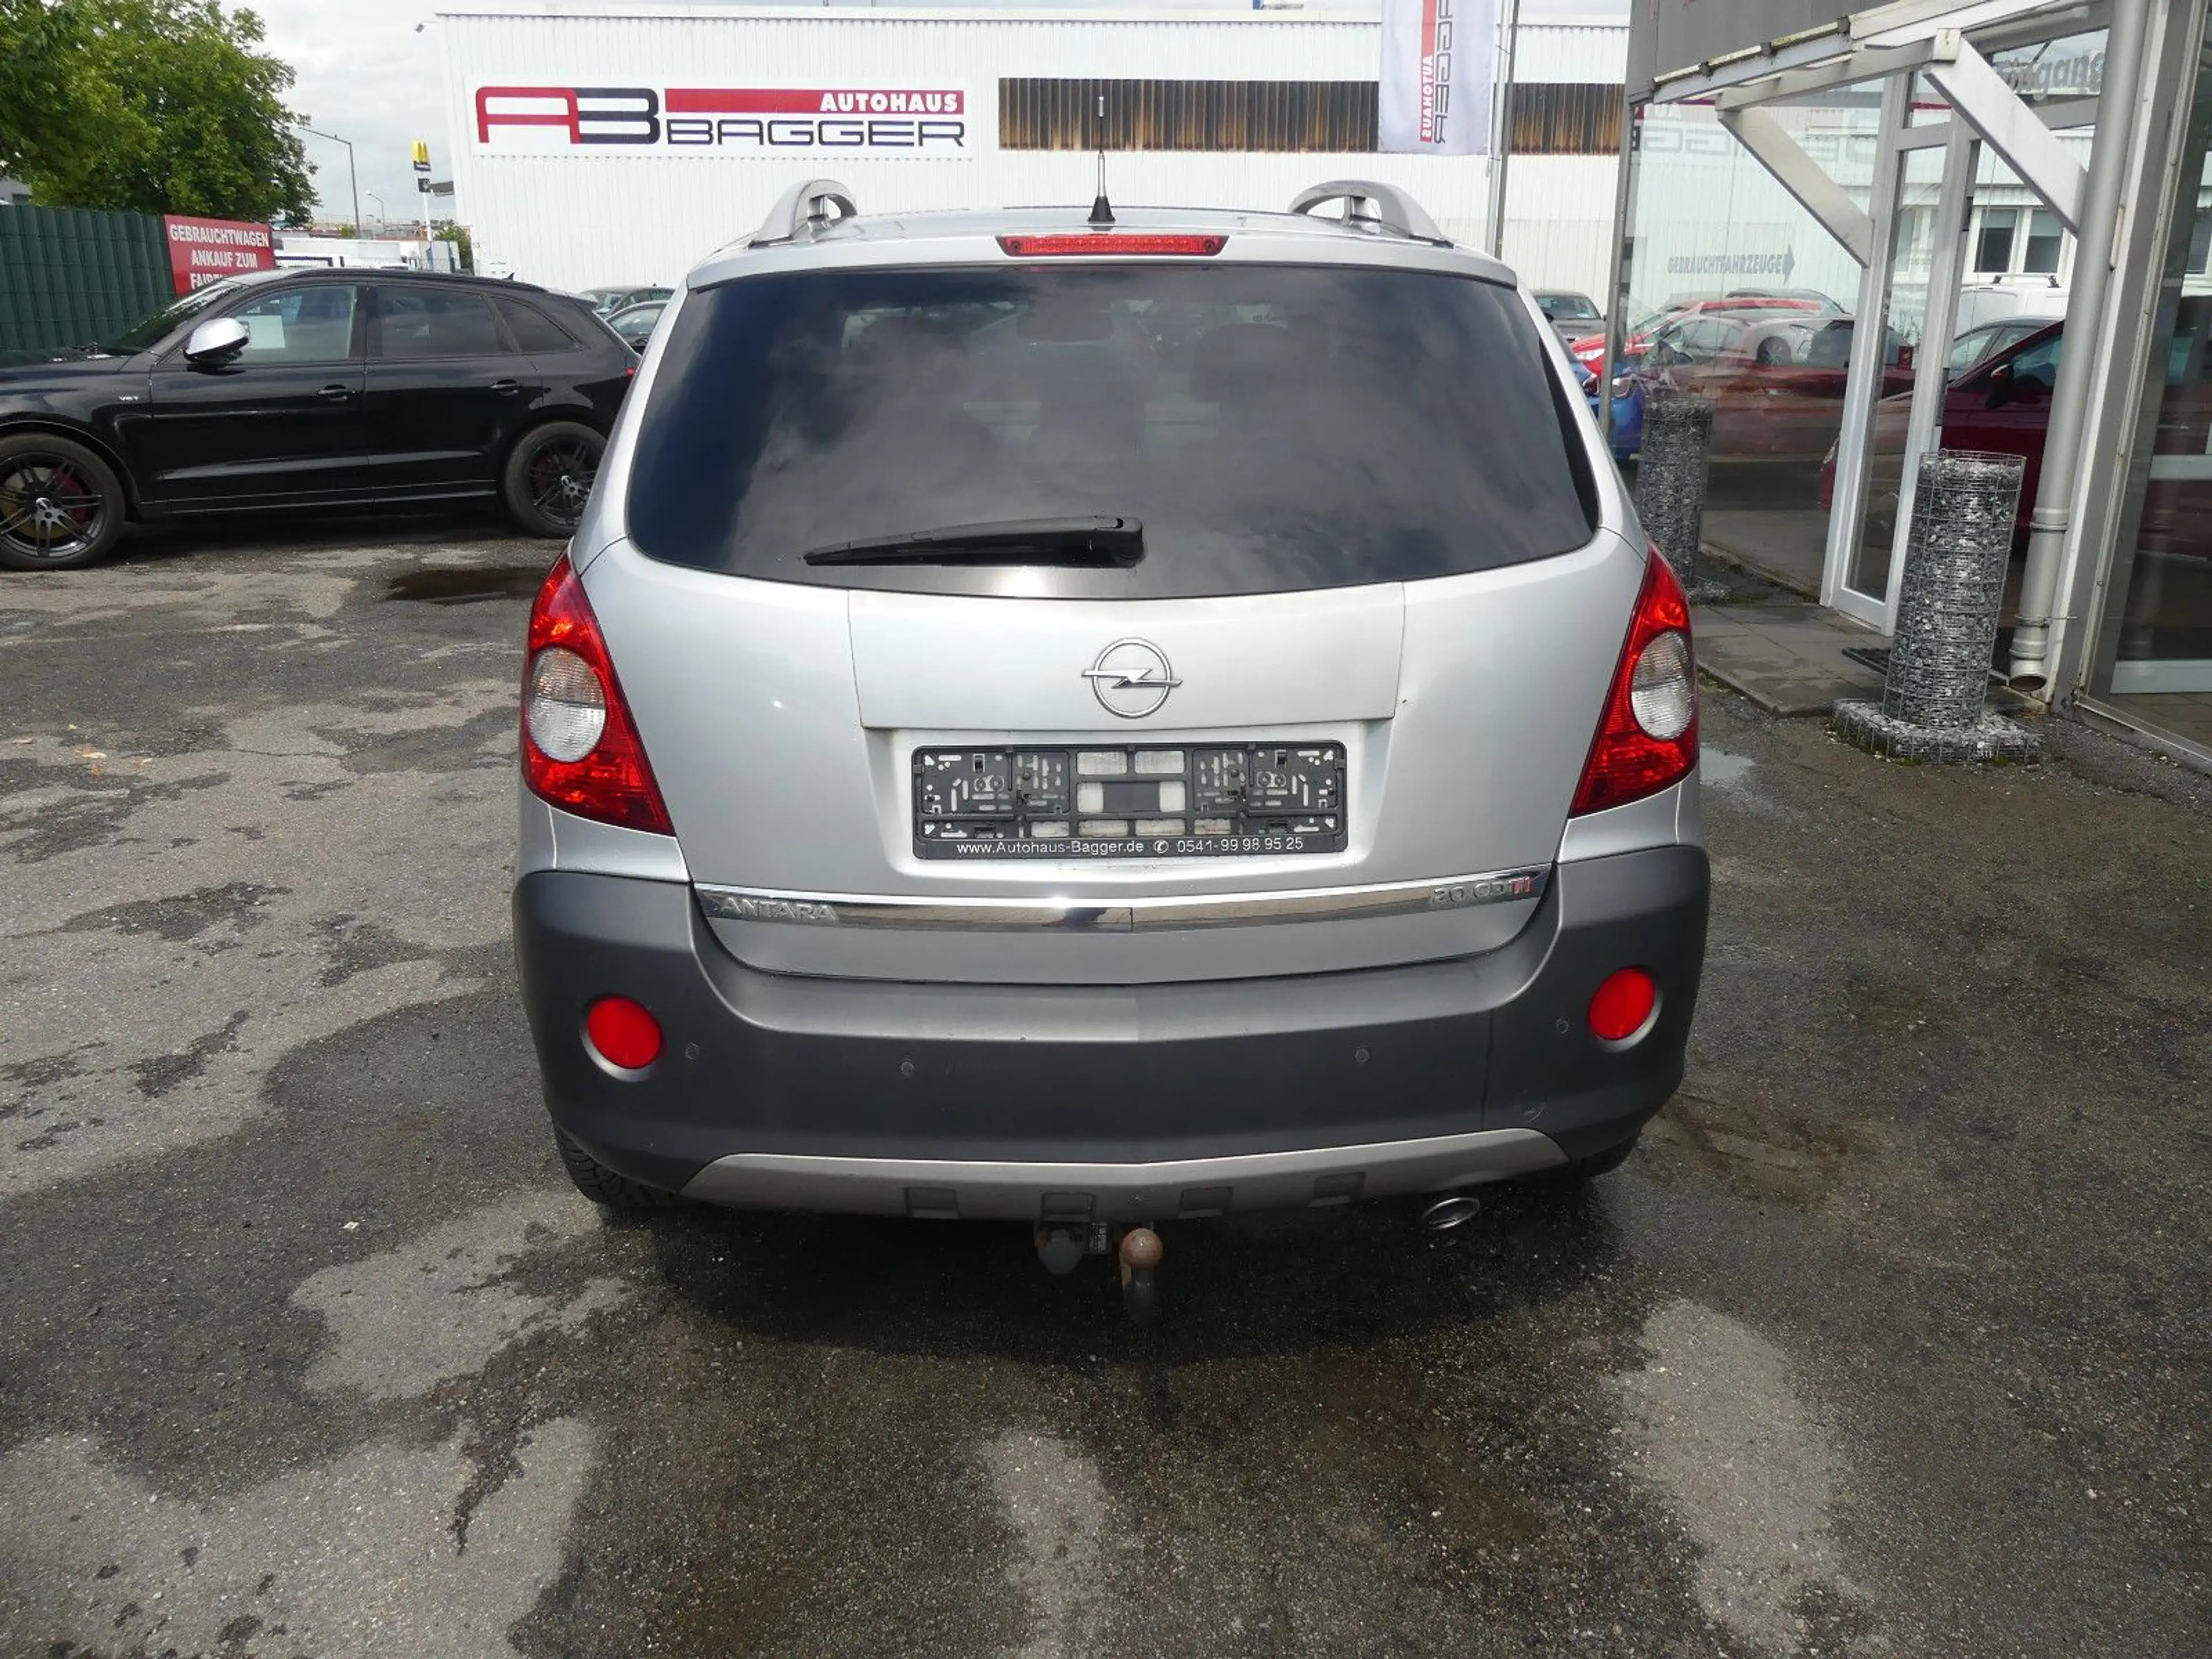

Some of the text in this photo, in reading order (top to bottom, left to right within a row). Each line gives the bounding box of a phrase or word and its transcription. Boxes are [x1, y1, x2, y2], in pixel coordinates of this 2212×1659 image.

[820, 92, 959, 112] AUTOHAUS
[1421, 55, 1434, 138] AUTOHAUS
[667, 118, 965, 148] BAGGER
[170, 224, 270, 247] GEBRAUCHTWAGEN
[191, 249, 258, 268] ANKAUF ZUM
[1666, 253, 1783, 274] GEBRAUCHTFAHRZEUGE
[956, 840, 1144, 855] www.Autohaus-Bagger.de
[1242, 838, 1260, 851] 98
[1264, 837, 1282, 850] 95
[1285, 836, 1304, 850] 25
[720, 896, 839, 922] ANTARA
